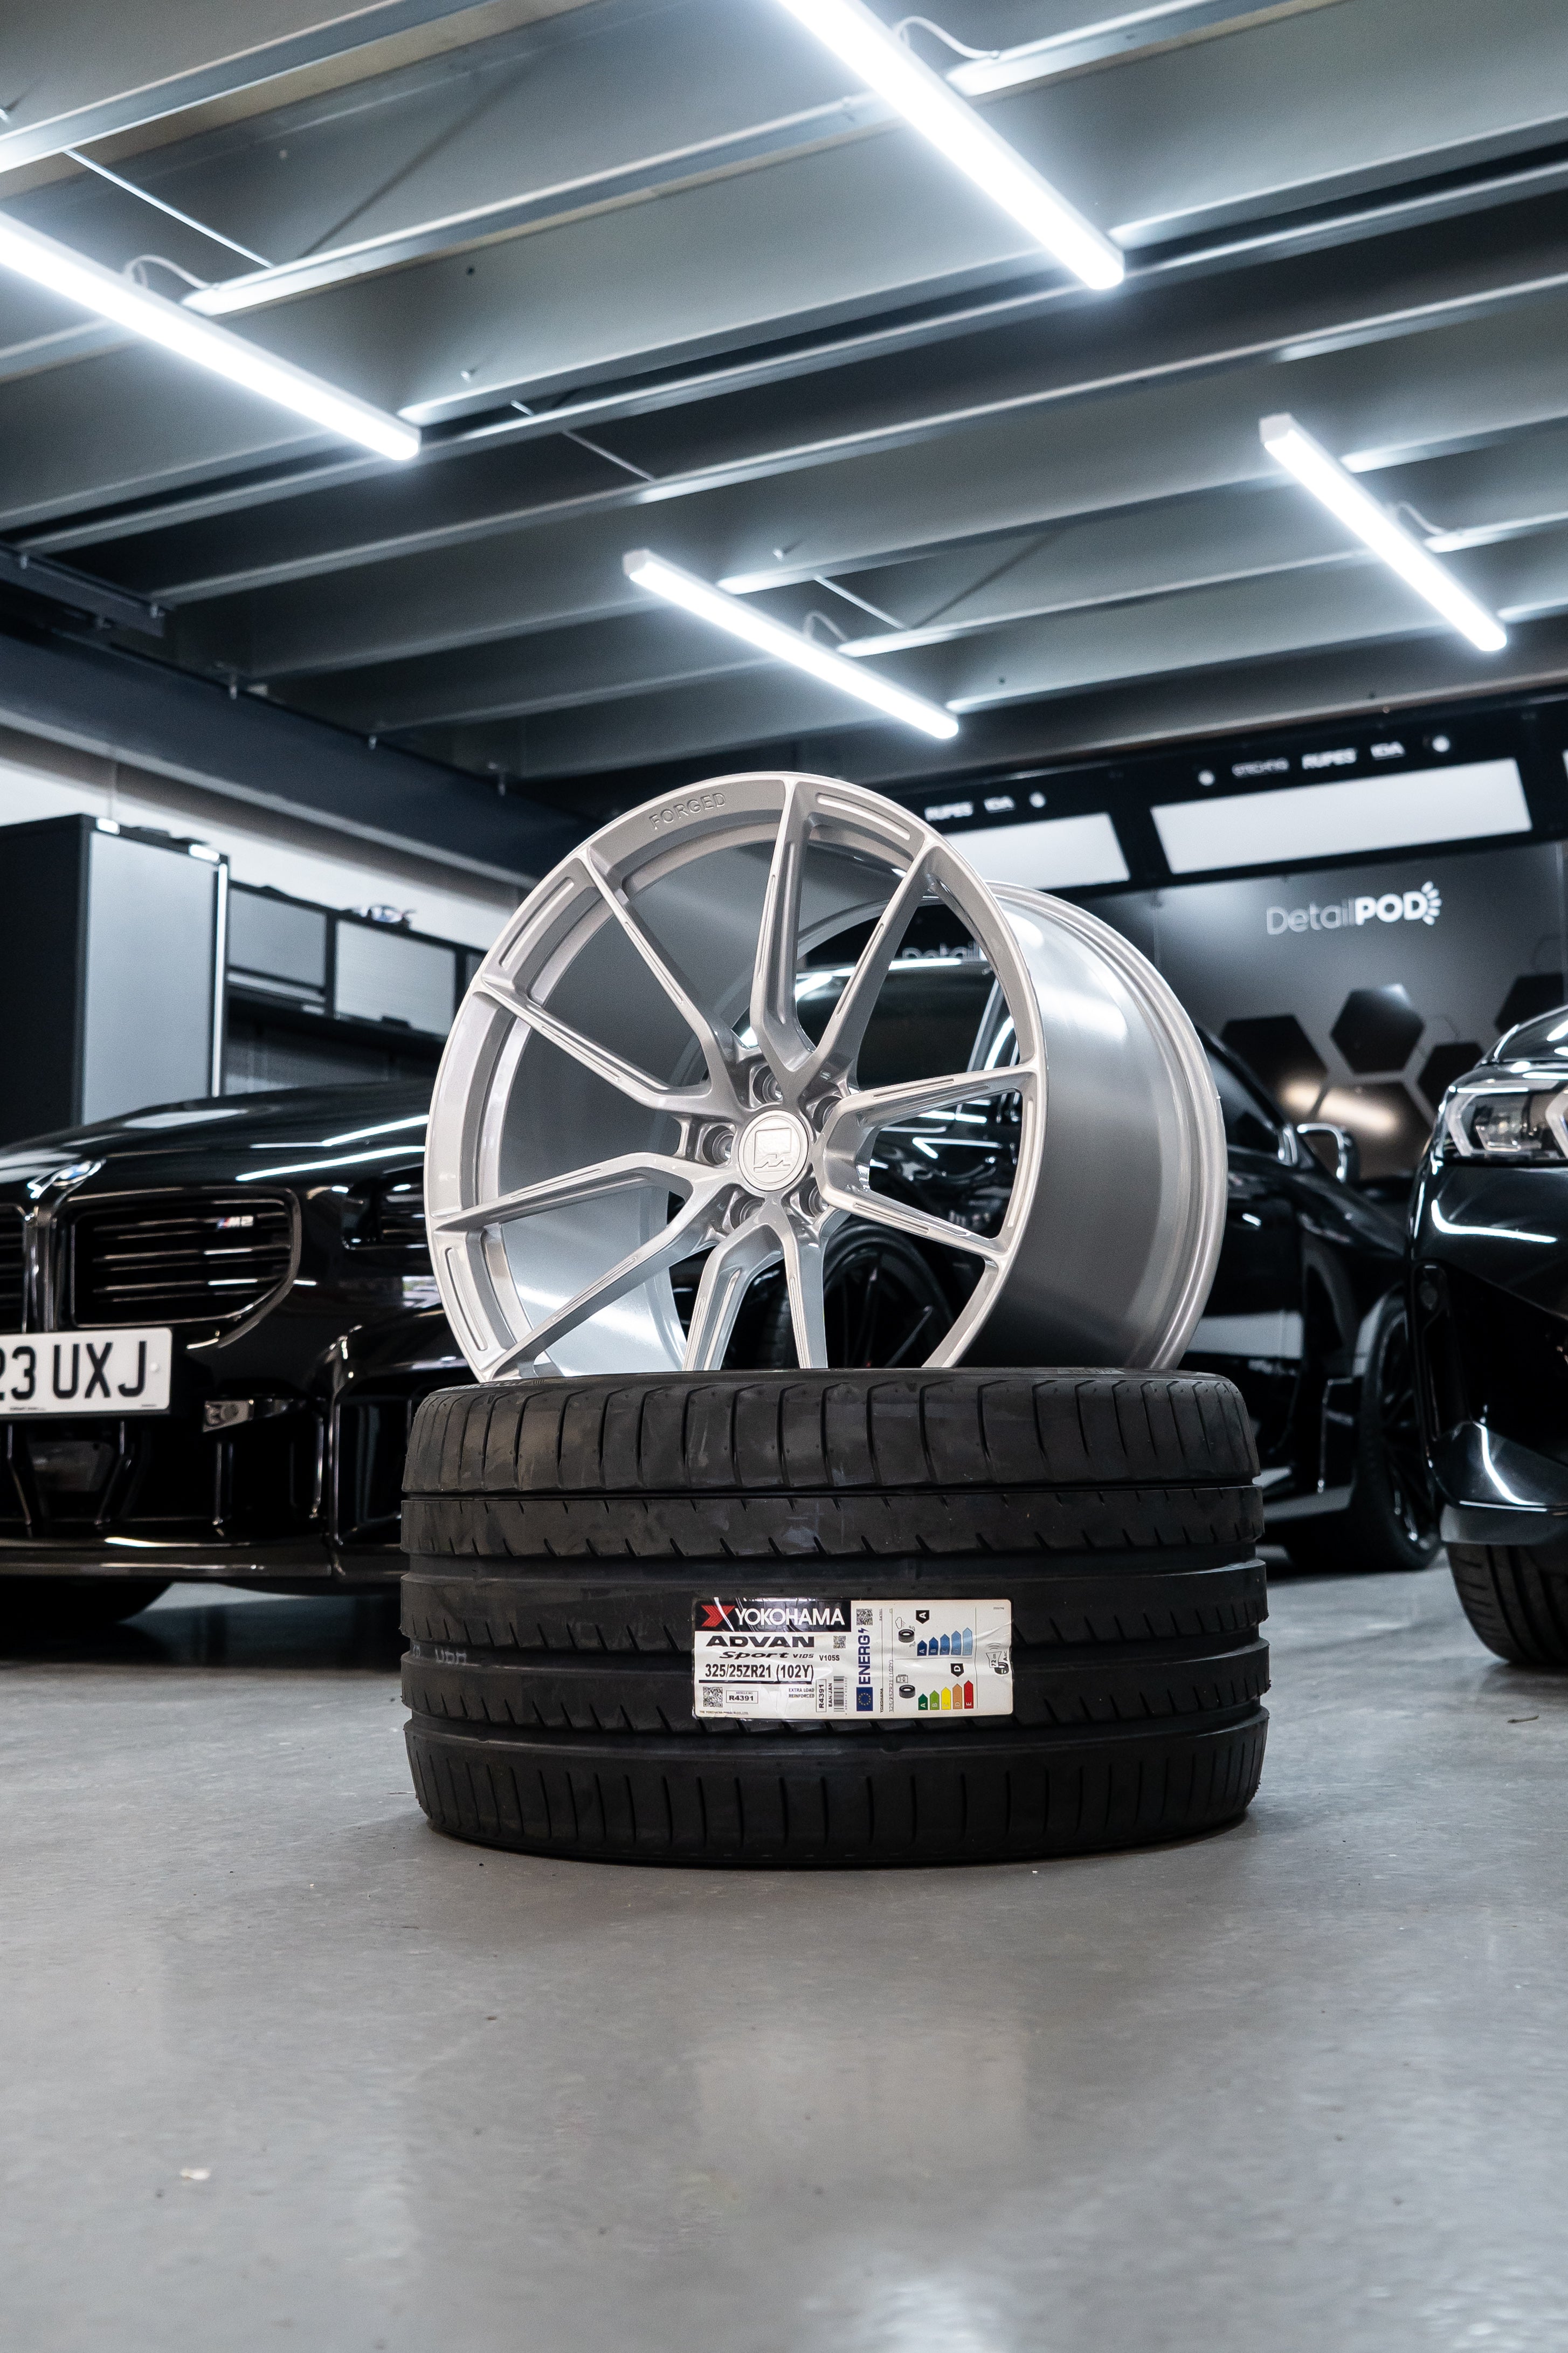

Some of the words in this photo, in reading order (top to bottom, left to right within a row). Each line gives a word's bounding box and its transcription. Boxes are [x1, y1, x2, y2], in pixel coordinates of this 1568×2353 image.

[649, 792, 727, 830] FORGED
[0, 1346, 36, 1400] 3
[53, 1340, 147, 1399] UXJ
[735, 1608, 845, 1625] YOKOHAMA
[706, 1635, 814, 1648] ADVAN
[719, 1651, 789, 1660] Sport
[858, 1635, 871, 1684] ENERG
[705, 1663, 771, 1678] 325/25ZR21
[776, 1664, 814, 1680] (102Y)
